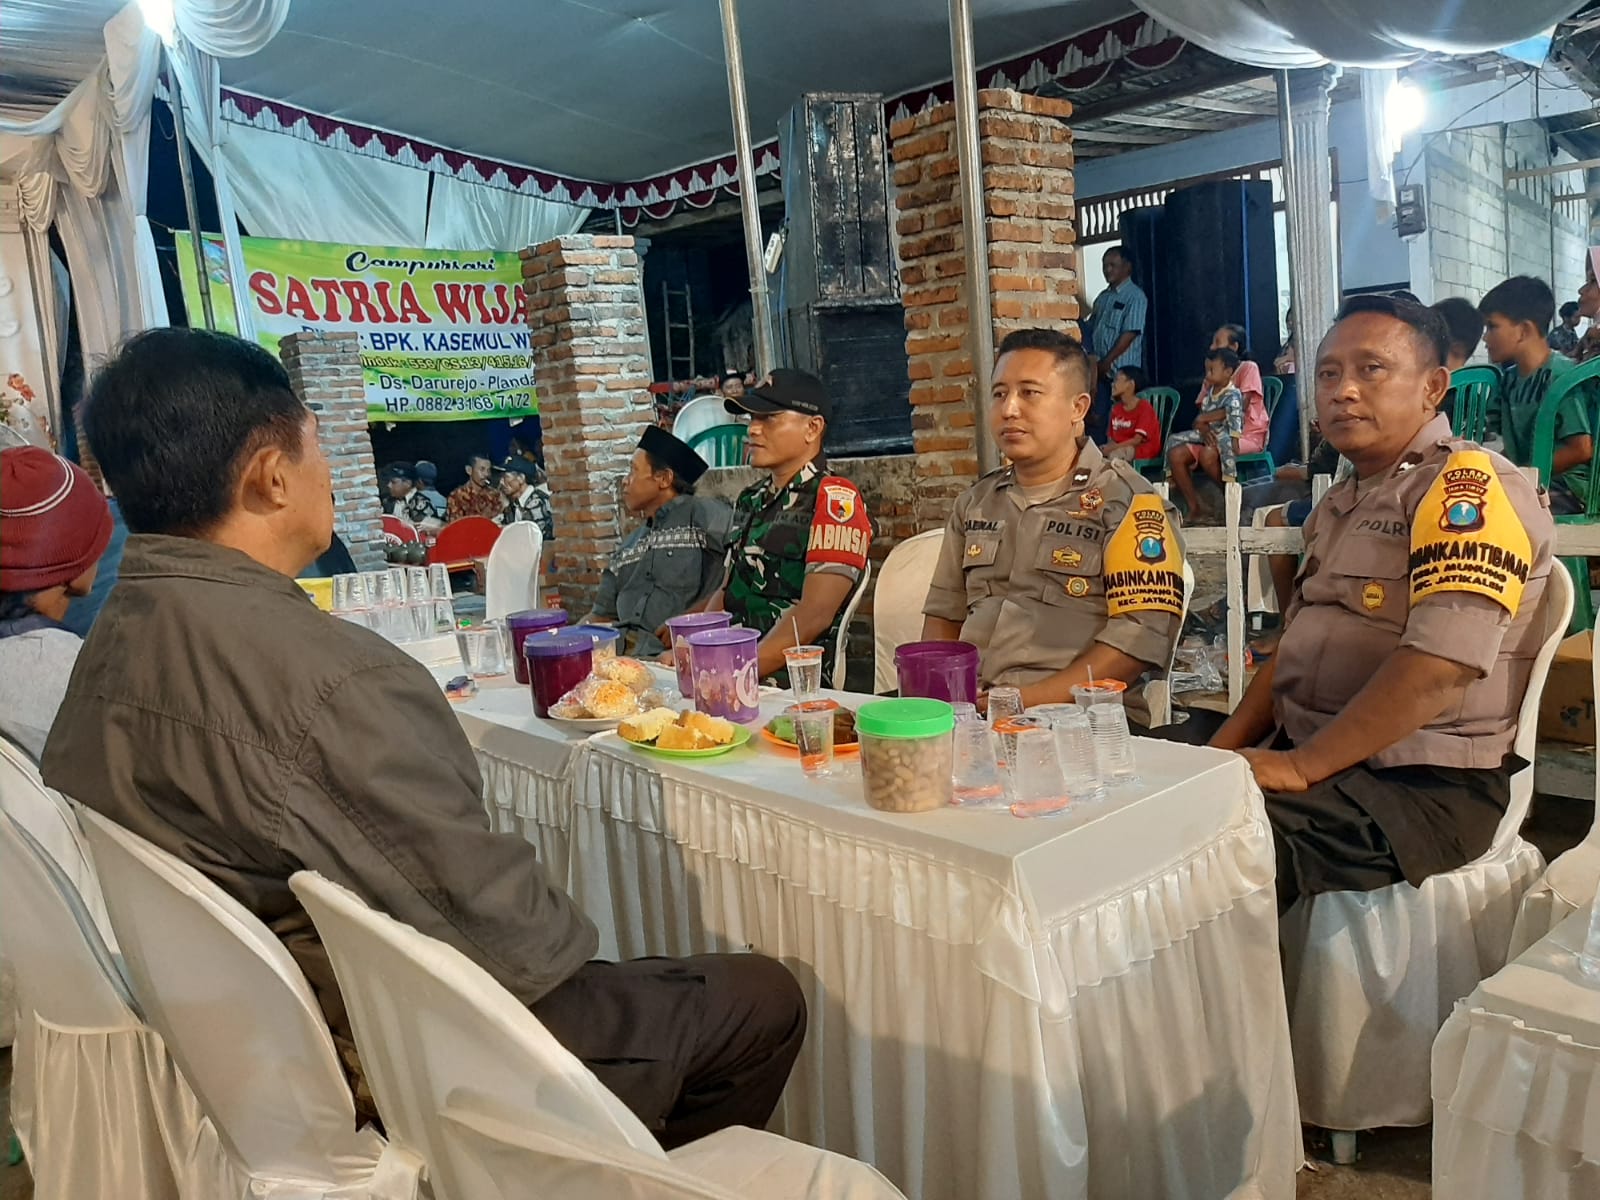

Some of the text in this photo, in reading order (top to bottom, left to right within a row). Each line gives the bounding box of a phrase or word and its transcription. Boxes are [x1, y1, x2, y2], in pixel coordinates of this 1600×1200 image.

[346, 250, 496, 276] Campursari
[249, 271, 432, 324] SATRIA
[369, 332, 419, 351] BPK.
[423, 332, 511, 351] KASEMUL
[379, 374, 407, 390] Ds.
[411, 374, 478, 394] Darurejo
[456, 396, 494, 411] 3168
[496, 392, 531, 409] 7172
[1046, 520, 1101, 541] POLISI
